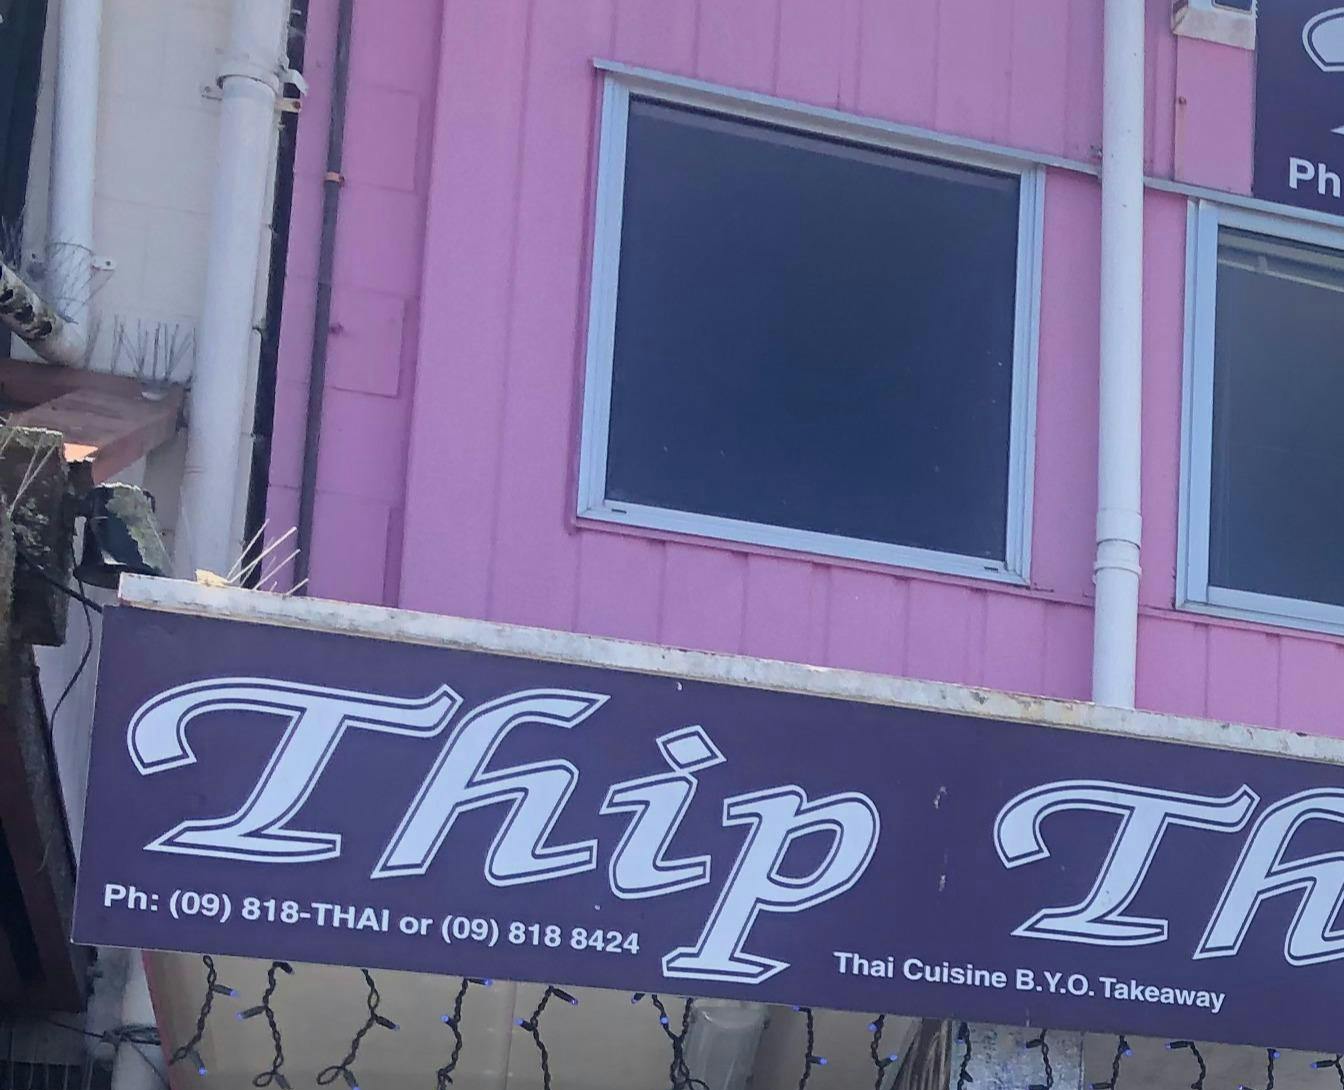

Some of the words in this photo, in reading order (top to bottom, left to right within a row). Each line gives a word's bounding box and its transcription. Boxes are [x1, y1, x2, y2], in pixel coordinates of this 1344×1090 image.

[127, 676, 881, 984] Thip
[105, 884, 158, 910] Ph:
[170, 890, 231, 922] (09)
[242, 898, 389, 931] 818-THAI
[400, 917, 433, 934] or
[442, 915, 498, 946] (09)
[509, 922, 561, 947] 818
[571, 928, 639, 953] 8424
[834, 952, 893, 977] Thai
[904, 959, 1006, 987] Cuisine
[1016, 969, 1094, 995] B.Y.O.
[1099, 977, 1225, 1013] Takeaway
